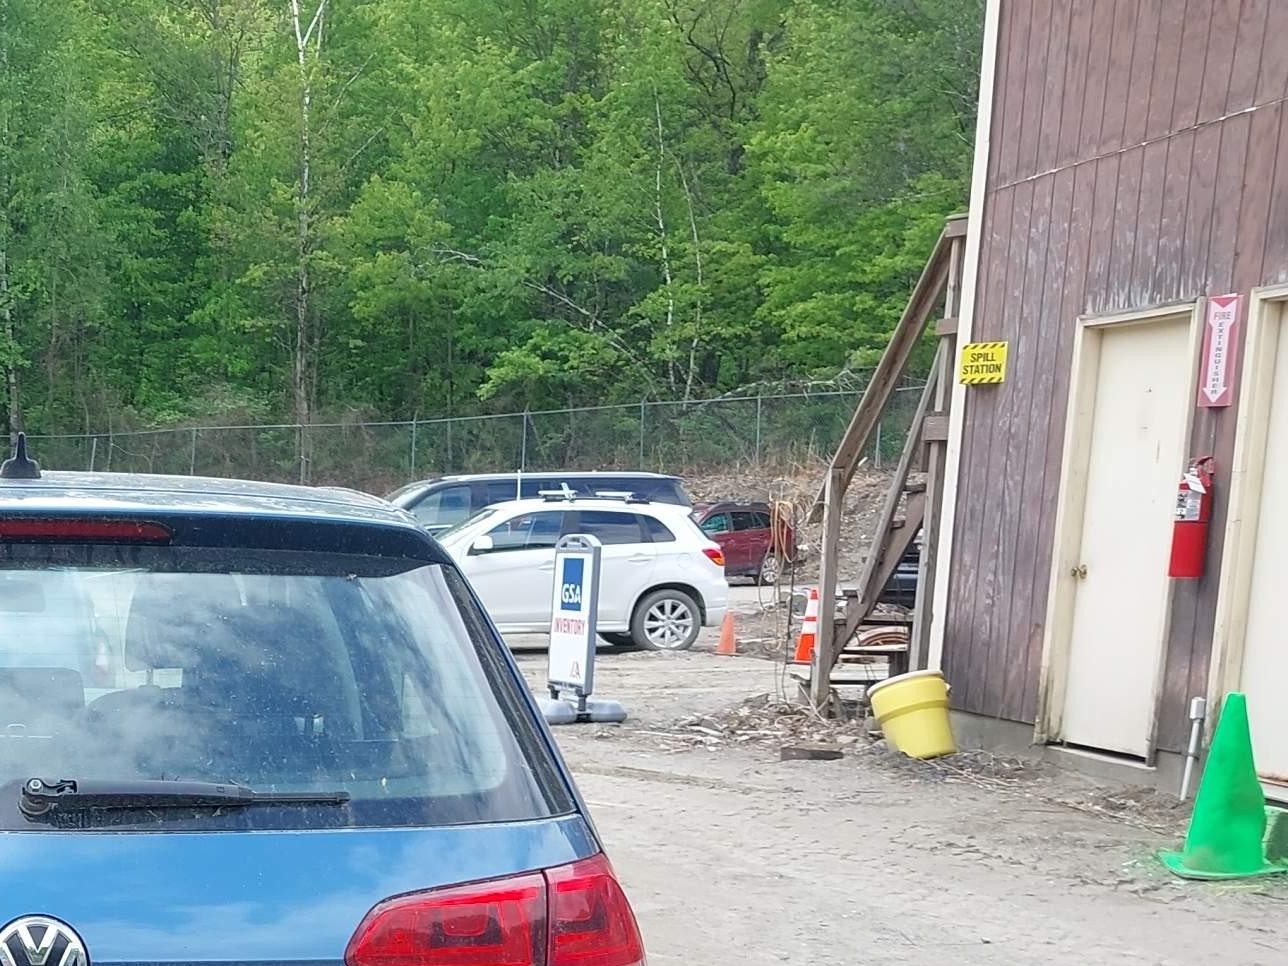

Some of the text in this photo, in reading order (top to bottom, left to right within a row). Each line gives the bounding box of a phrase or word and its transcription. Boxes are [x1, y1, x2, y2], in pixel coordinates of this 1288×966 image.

[1214, 311, 1232, 320] FIRE
[969, 352, 997, 363] SPILL
[962, 363, 1002, 375] STATION
[562, 583, 581, 604] GSA
[553, 617, 585, 636] INVENTORY
